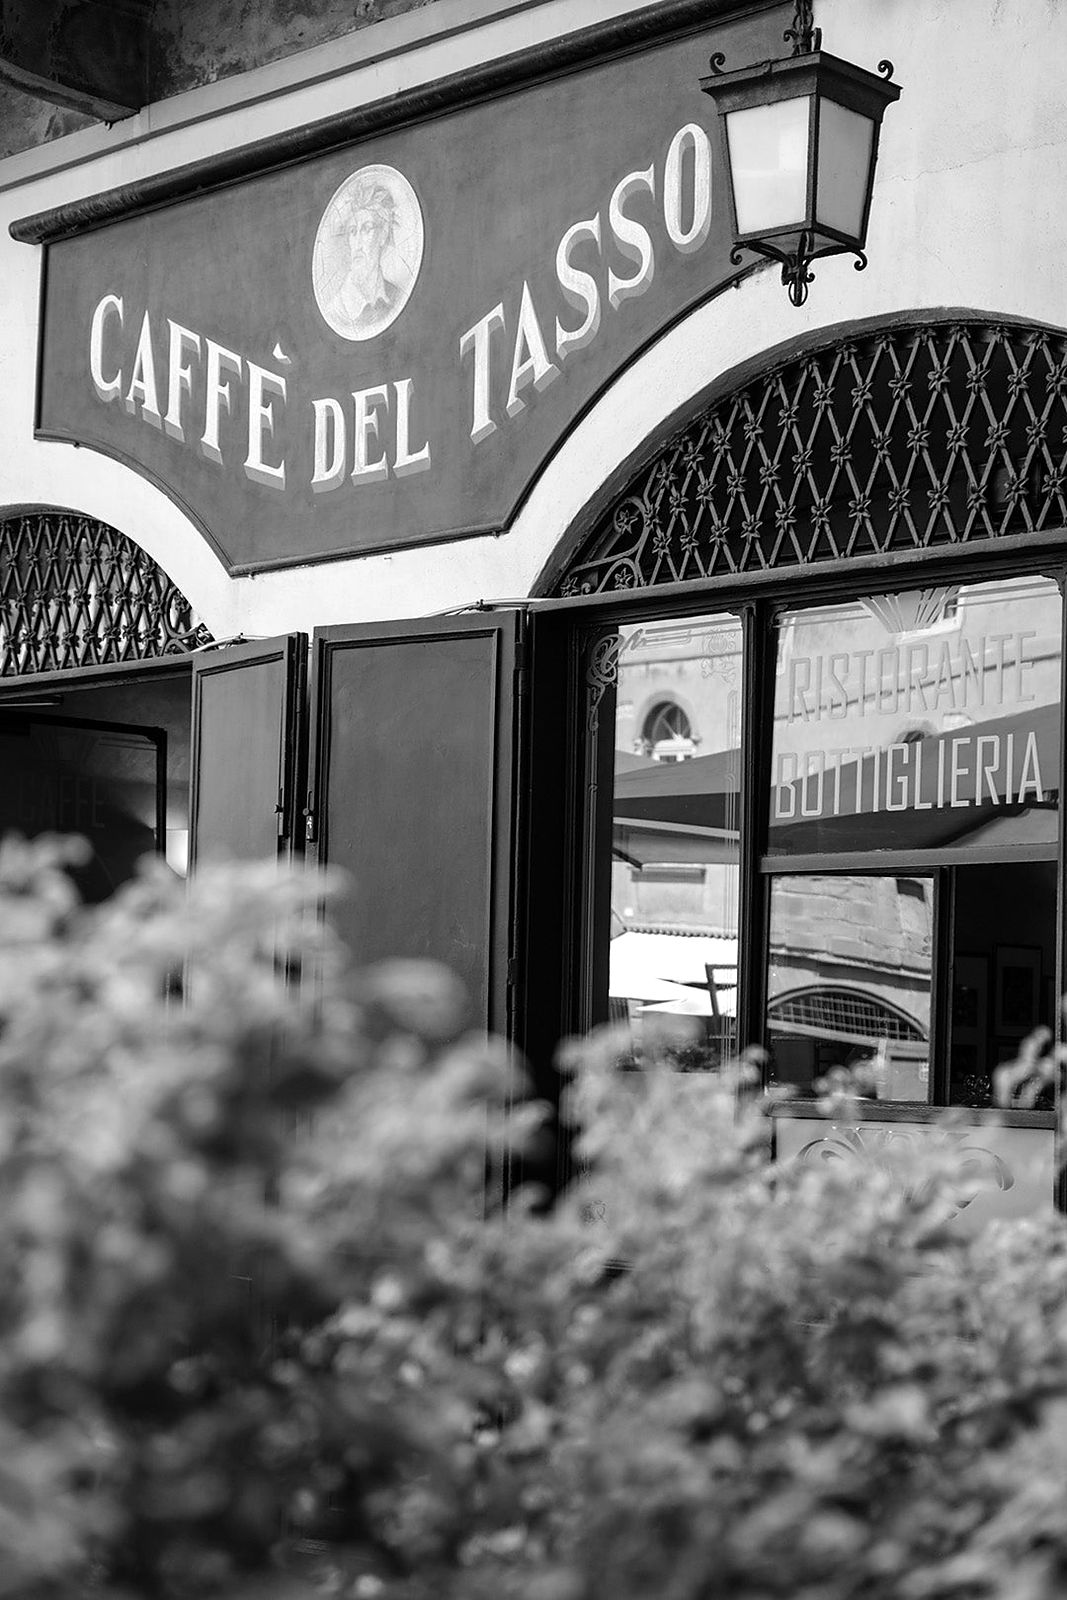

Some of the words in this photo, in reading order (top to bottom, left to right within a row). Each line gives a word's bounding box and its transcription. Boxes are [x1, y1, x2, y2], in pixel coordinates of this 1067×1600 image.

[89, 294, 292, 492] CAFFÈ
[311, 377, 431, 494] DEL
[459, 122, 713, 445] TASSO
[788, 631, 1037, 724] RISTORANTE
[774, 731, 1044, 819] BOTTIGLIERIA
